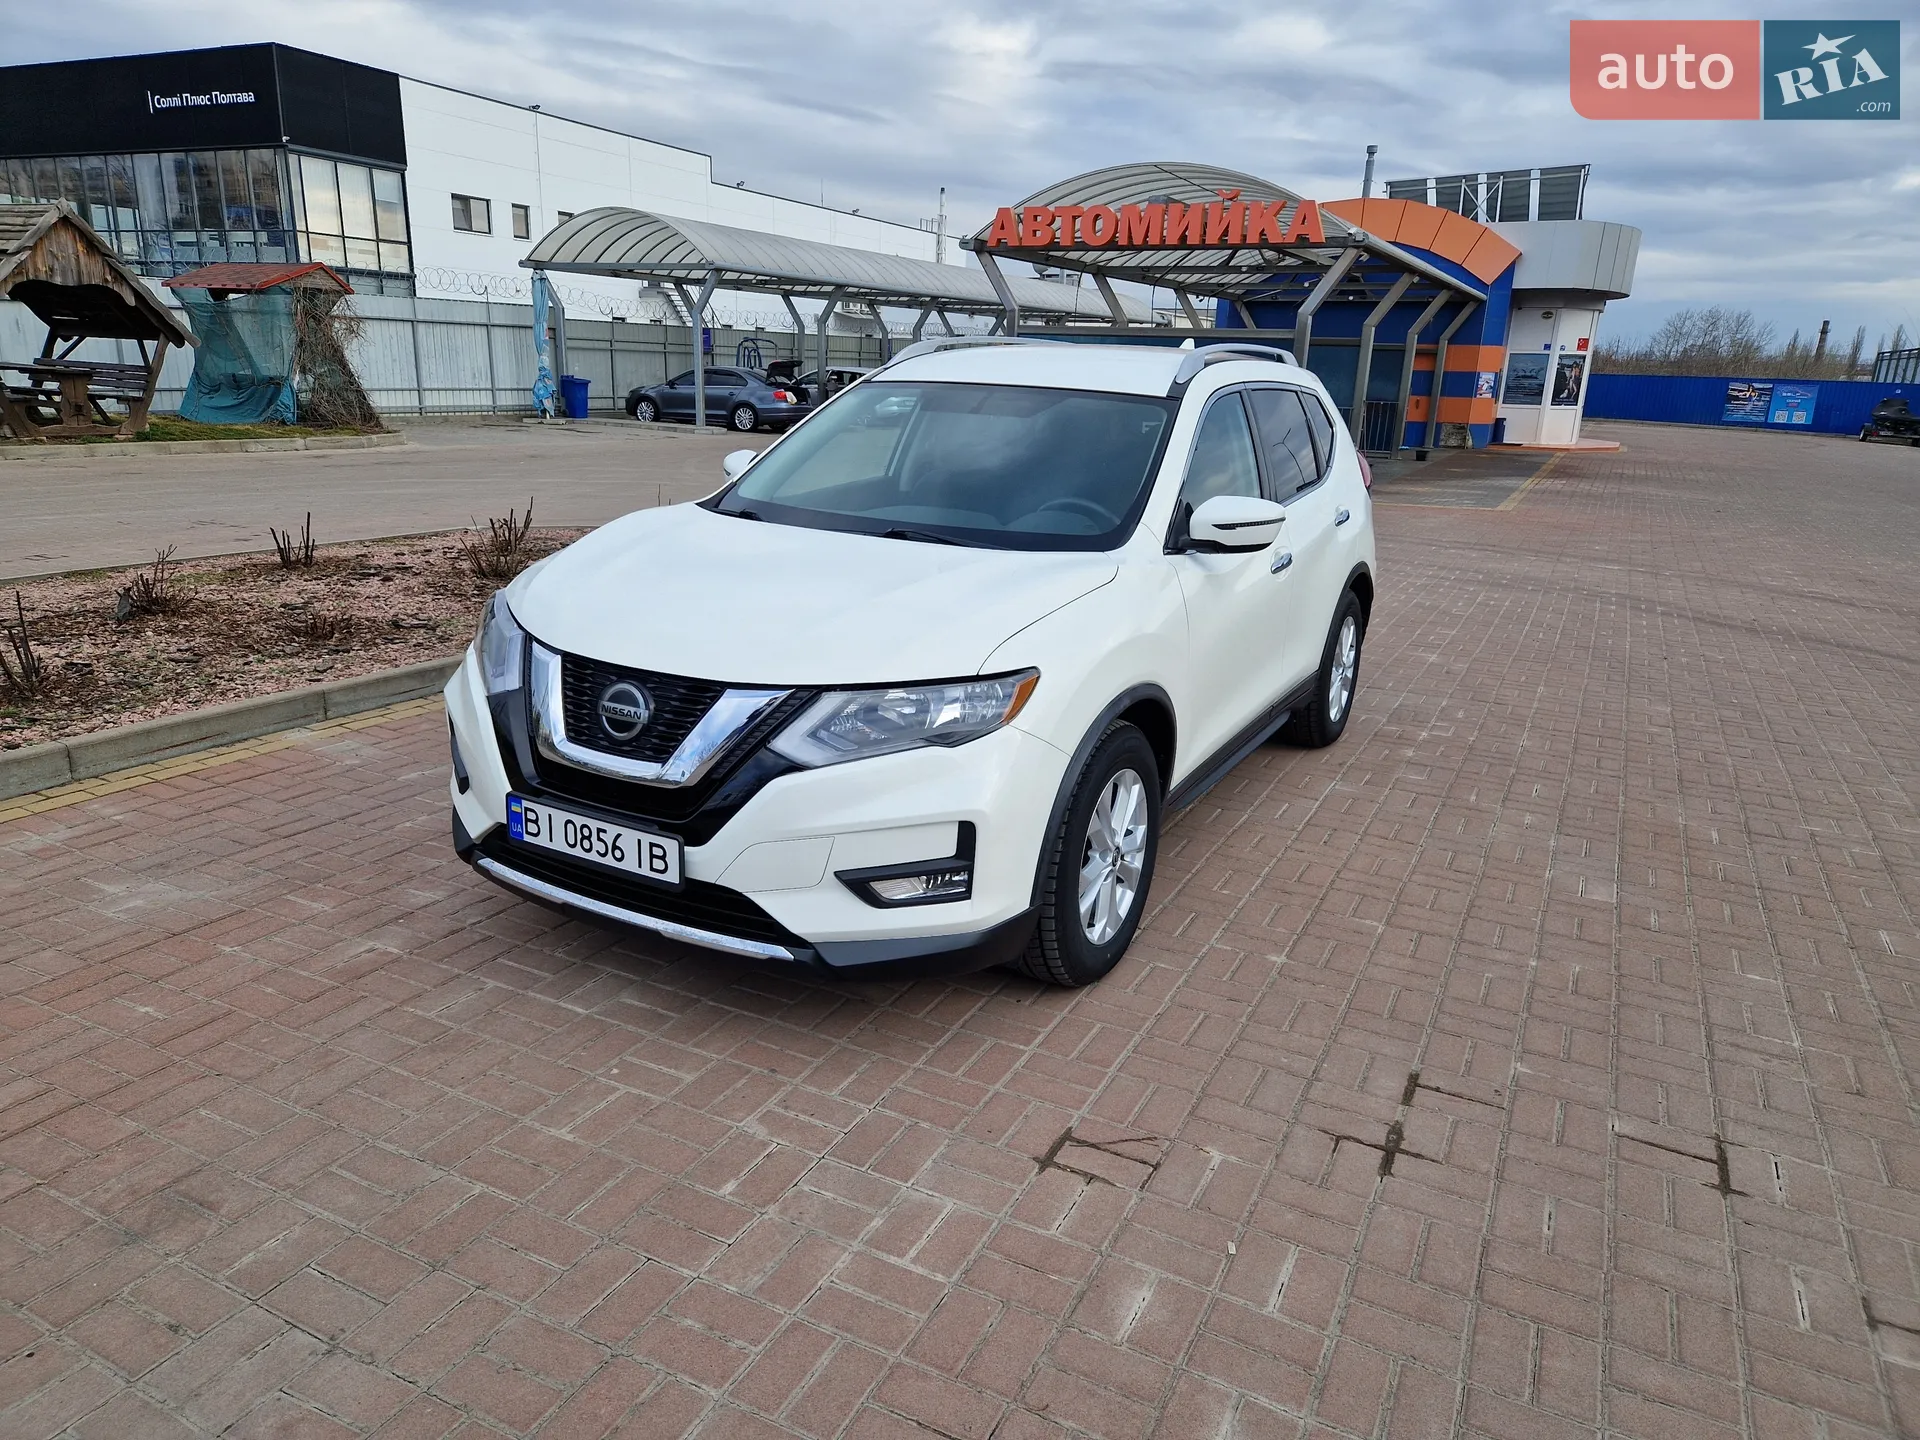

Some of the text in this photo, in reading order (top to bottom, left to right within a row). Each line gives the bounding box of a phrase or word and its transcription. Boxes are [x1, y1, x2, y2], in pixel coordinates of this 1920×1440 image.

[154, 91, 255, 108] Соллі Плюс Полтава
[987, 188, 1326, 247] АВТОМИЙКА
[601, 704, 642, 720] NISSAN
[511, 822, 523, 833] UA
[523, 806, 669, 875] BI 0856 IB
